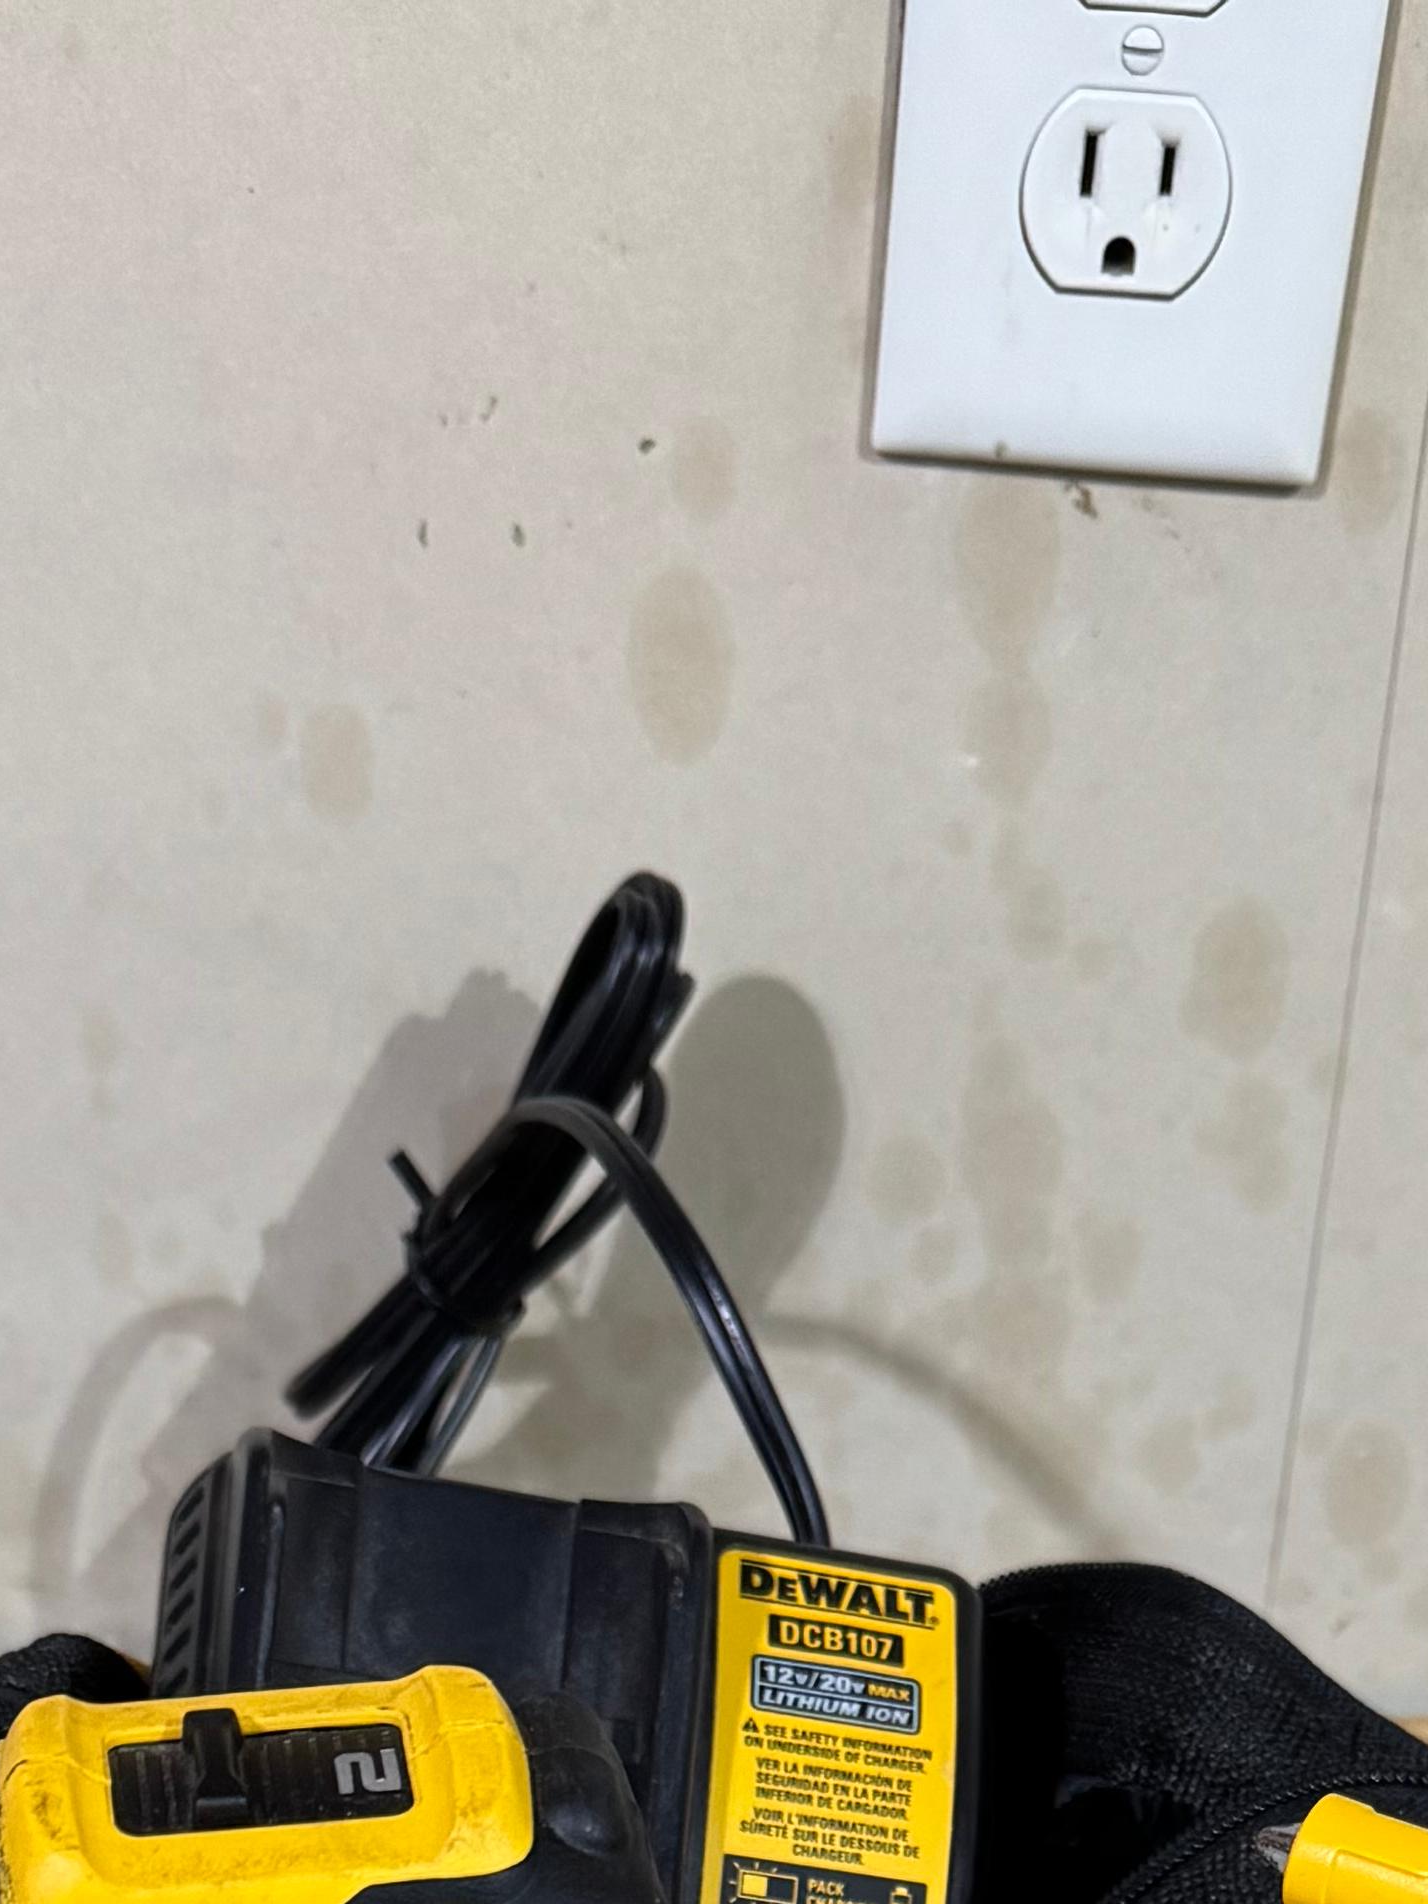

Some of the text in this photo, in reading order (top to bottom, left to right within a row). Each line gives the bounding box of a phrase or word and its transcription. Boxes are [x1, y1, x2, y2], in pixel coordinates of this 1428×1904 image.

[740, 1564, 933, 1624] DEWALT
[778, 1619, 892, 1660] DCB107
[762, 1688, 909, 1726] LITHIUM ION
[867, 1683, 910, 1702] MAX
[744, 1734, 763, 1748] ON
[767, 1738, 840, 1760] UNDERSIDE
[844, 1751, 859, 1763] OF
[763, 1723, 931, 1761] SEE SAFETY INFORMATION
[333, 1748, 401, 1795] 2
[755, 1770, 911, 1806] SEGURIDAD EN LA PARTE
[756, 1756, 912, 1792] VER LA INFORMACIÓN DE
[755, 1785, 813, 1806] INFERIOR
[817, 1795, 832, 1809] DE
[753, 1806, 784, 1823] VOIR
[892, 1827, 908, 1842] DE
[792, 1827, 818, 1843] SUR
[822, 1832, 835, 1845] LE
[839, 1834, 898, 1856] DESSOUS
[903, 1844, 920, 1859] DE
[807, 1878, 844, 1896] PACK
